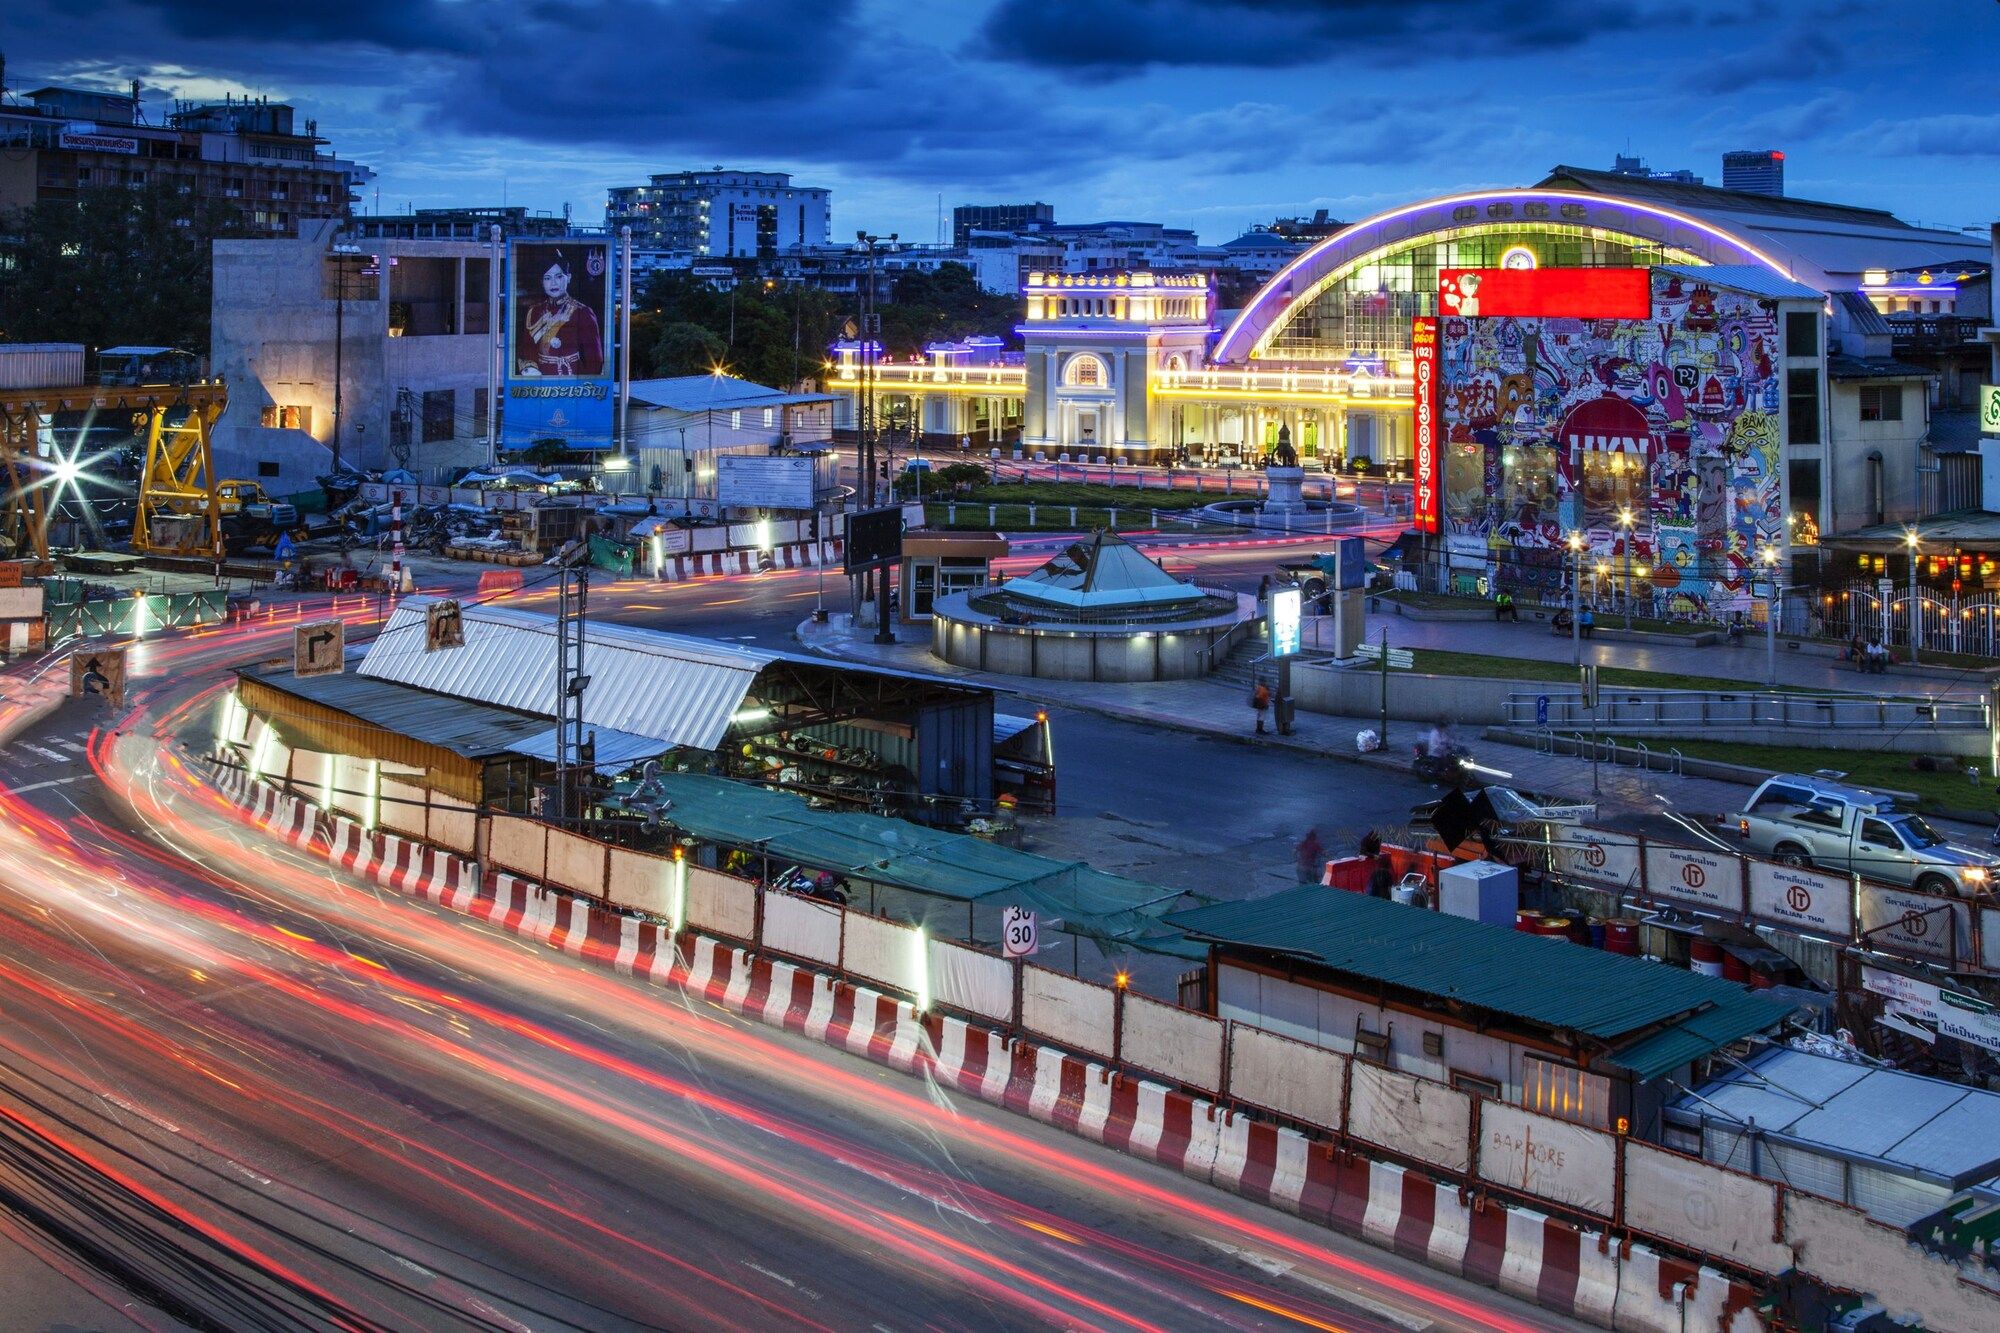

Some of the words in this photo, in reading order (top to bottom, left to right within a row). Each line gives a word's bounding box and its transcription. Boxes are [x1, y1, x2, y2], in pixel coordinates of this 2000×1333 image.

[1555, 335, 1570, 346] HK
[1415, 347, 1433, 359] (02)
[511, 382, 608, 400] ทรงพระเจริญ
[1742, 415, 1765, 428] BAM
[1540, 699, 1546, 711] P
[1574, 864, 1599, 875] ITALIAN
[1604, 870, 1619, 878] THAI
[1670, 885, 1698, 896] ITALIAN
[1702, 892, 1719, 900] THAI
[1774, 905, 1803, 919] ITALIAN
[1807, 914, 1825, 924] THAI
[1012, 926, 1031, 944] 30
